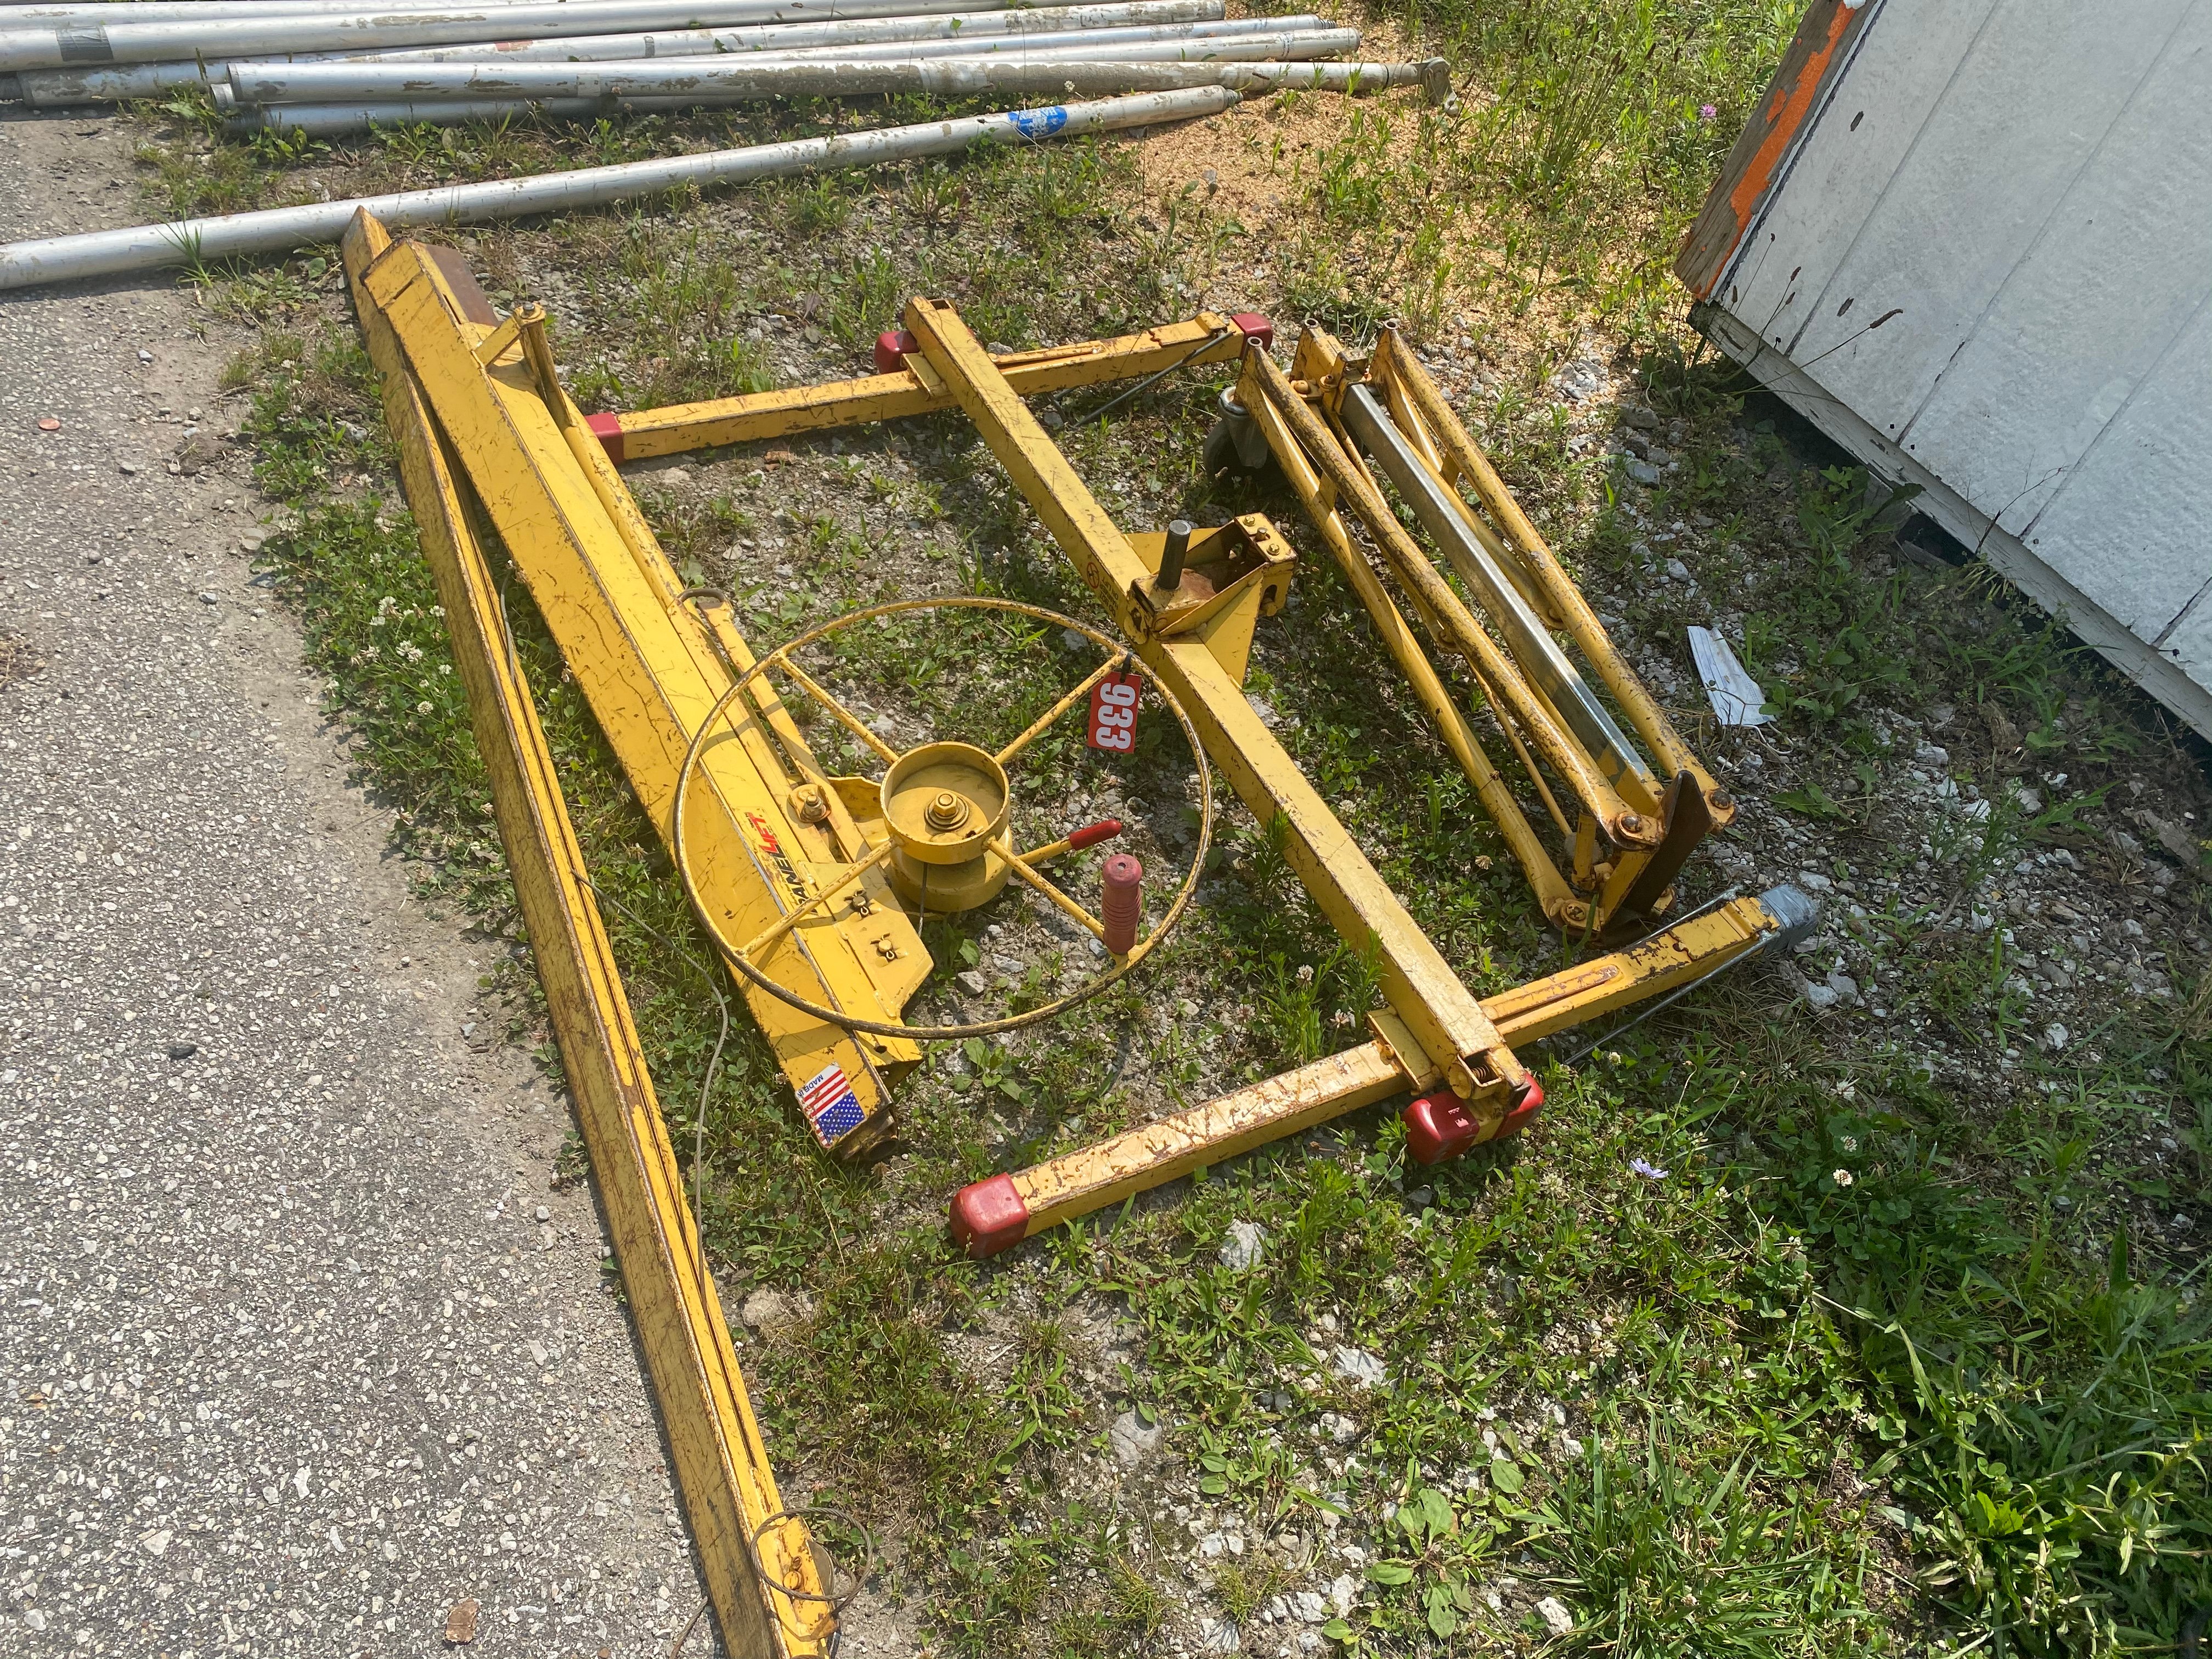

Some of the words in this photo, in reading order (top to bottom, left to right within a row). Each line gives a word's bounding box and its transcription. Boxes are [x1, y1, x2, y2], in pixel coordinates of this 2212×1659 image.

[1109, 605, 1116, 617] DO
[1096, 682, 1136, 749] 933
[804, 1074, 823, 1093] MADE
